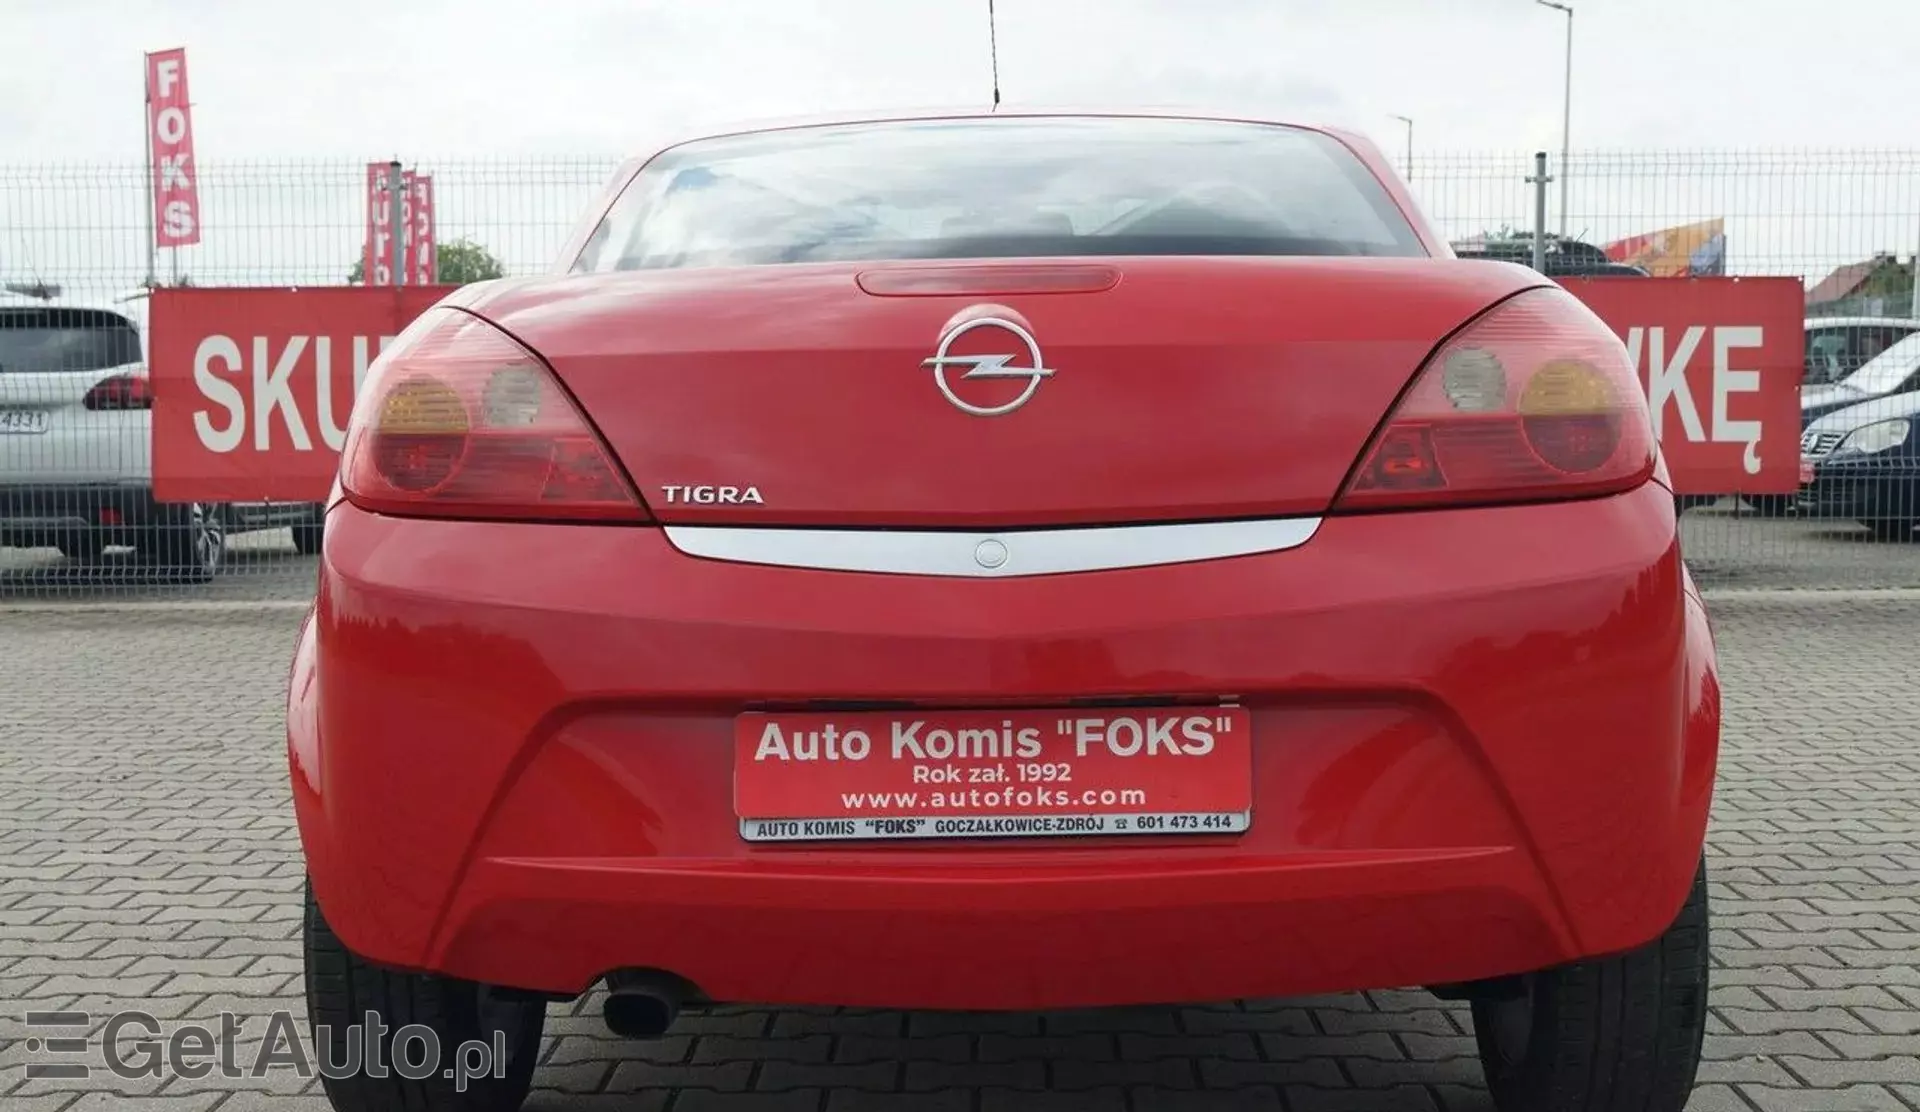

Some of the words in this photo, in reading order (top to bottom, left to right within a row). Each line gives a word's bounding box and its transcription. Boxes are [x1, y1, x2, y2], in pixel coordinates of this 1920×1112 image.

[157, 60, 195, 237] FOKS
[193, 334, 396, 453] SKU
[1627, 326, 1763, 474] KĘ
[661, 485, 764, 504] TIGRA
[754, 722, 871, 761] Auto
[891, 720, 1042, 758] Komis
[1057, 716, 1232, 756] "FOKS"
[913, 764, 961, 784] Rok
[968, 763, 1010, 783] zał.
[1017, 763, 1072, 782] 1992
[841, 786, 1146, 809] www.autofoks.com
[757, 820, 799, 837] AUTO
[804, 819, 855, 836] KOMIS
[865, 818, 926, 834] “FOKS”
[935, 814, 1104, 833] GOCZAŁKOWICE-ZDRÓJ
[1137, 816, 1164, 829] 601
[1170, 815, 1198, 828] 473
[1203, 814, 1232, 828] 414
